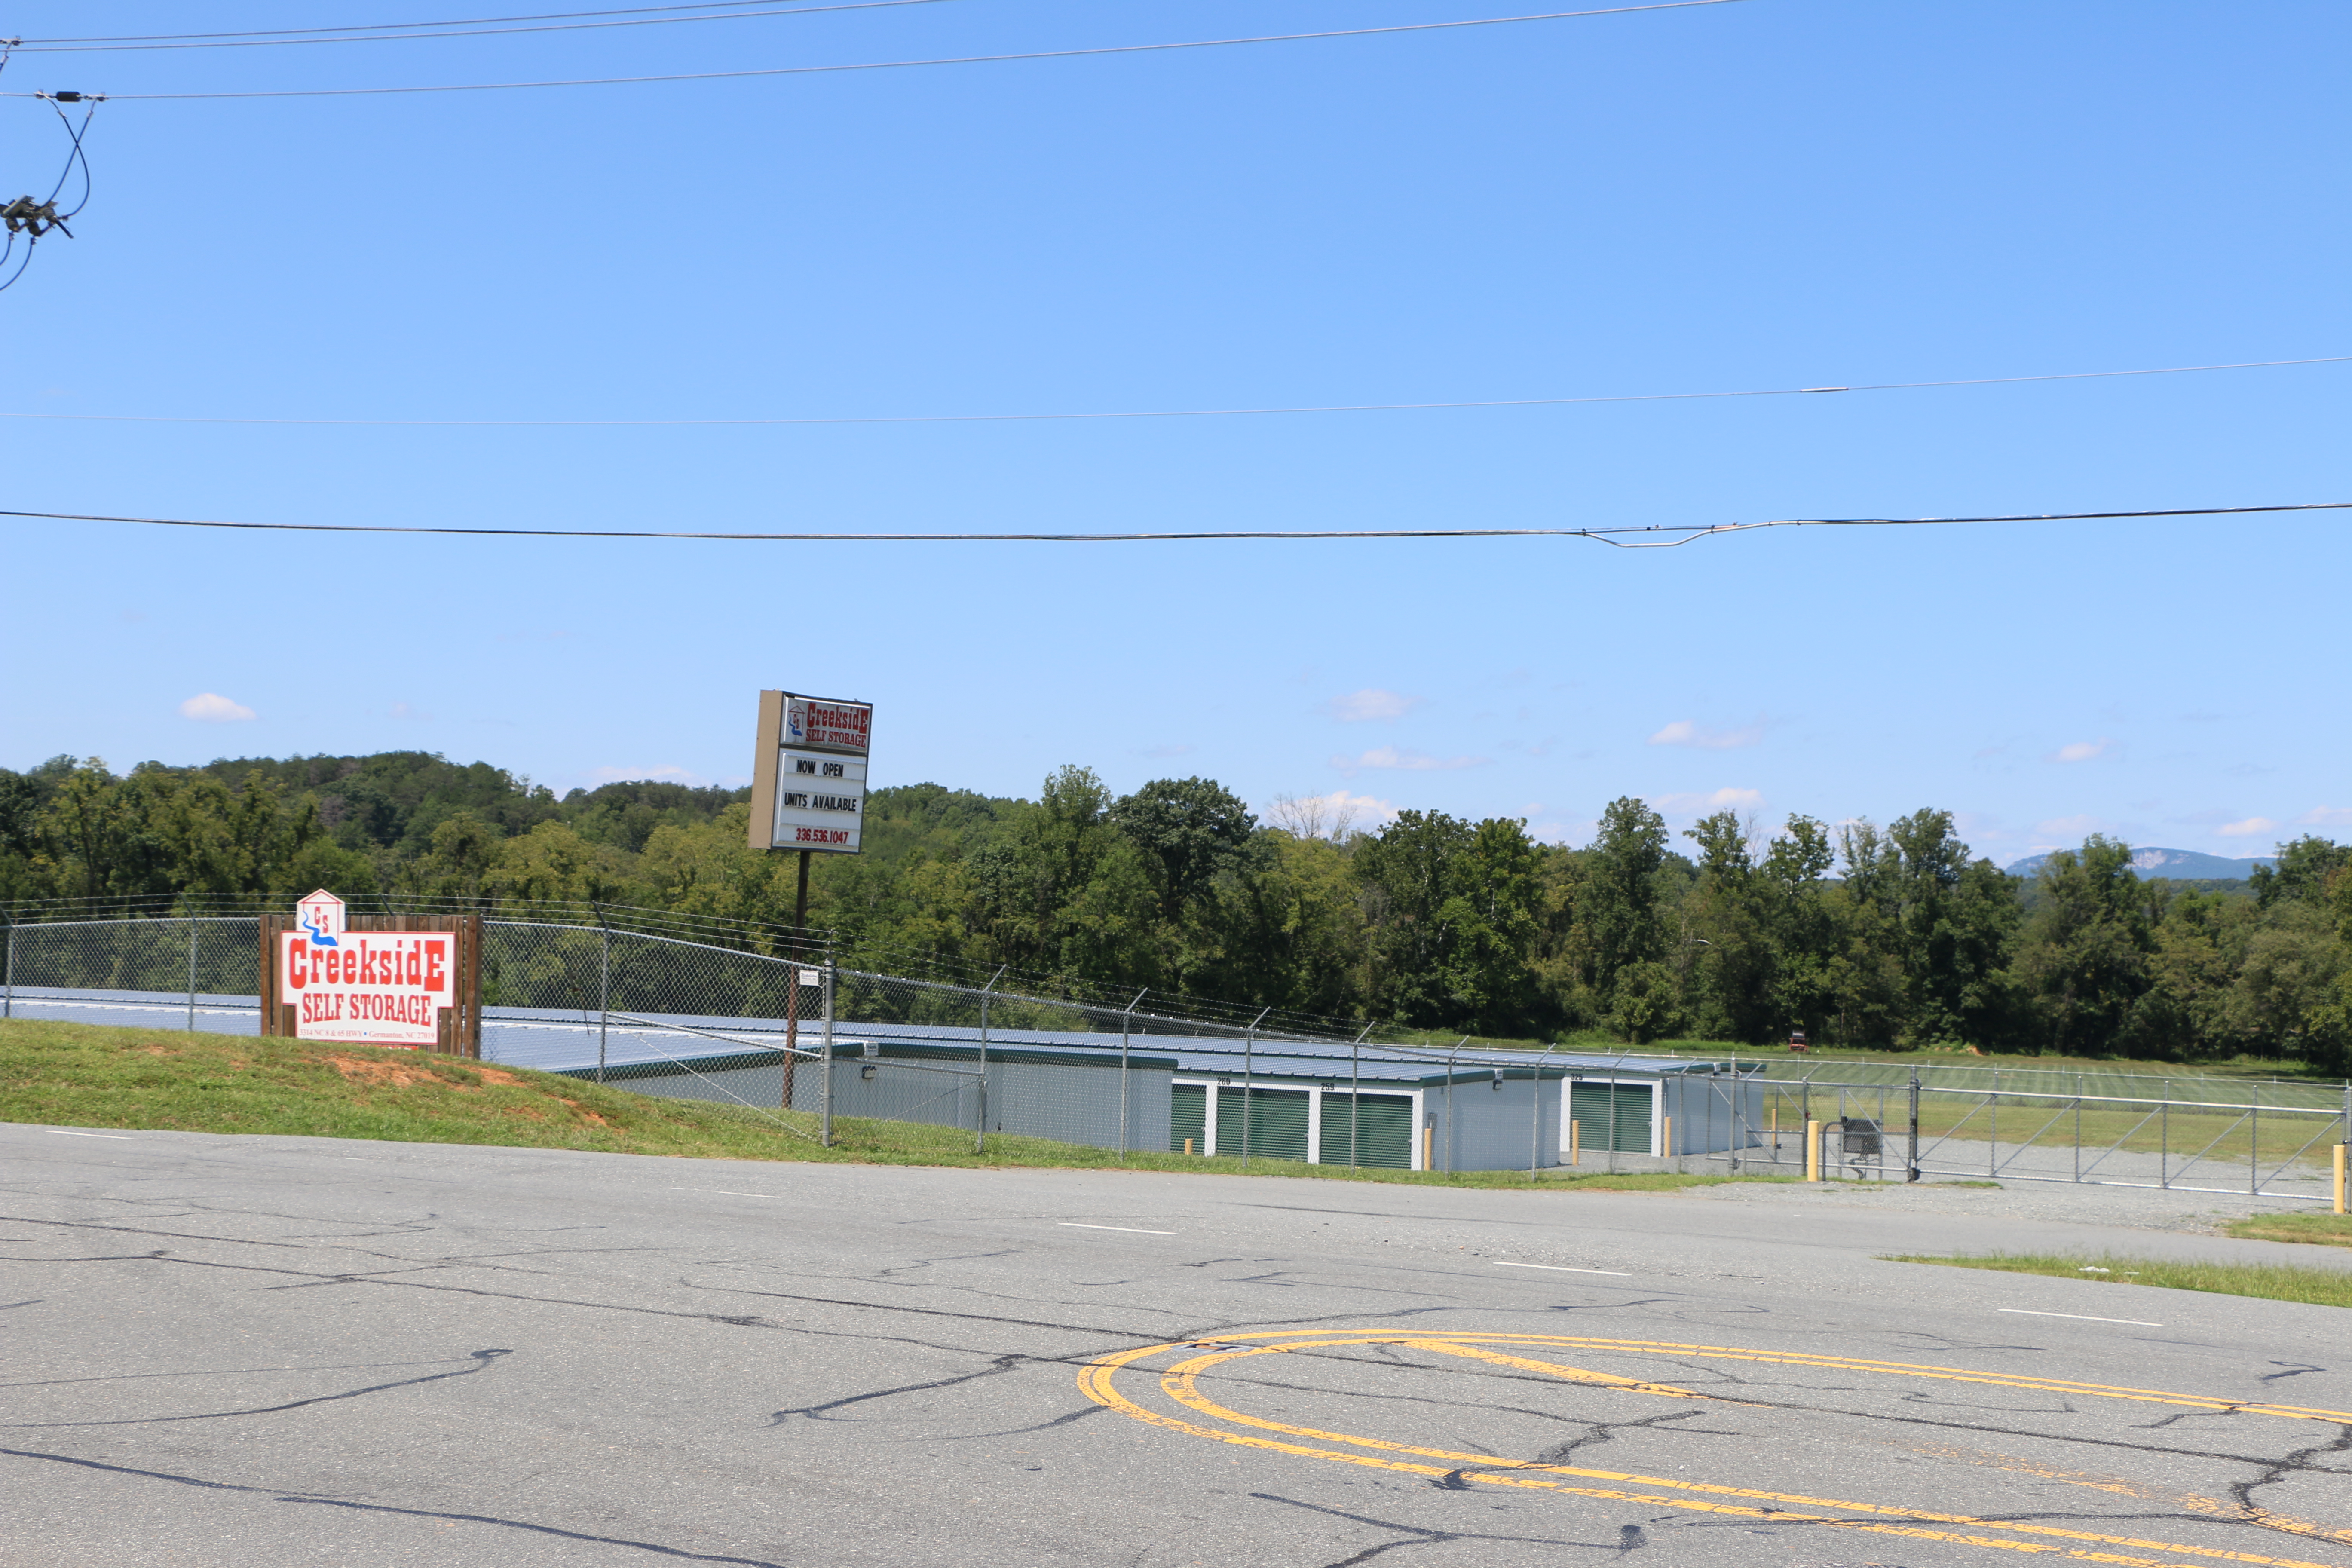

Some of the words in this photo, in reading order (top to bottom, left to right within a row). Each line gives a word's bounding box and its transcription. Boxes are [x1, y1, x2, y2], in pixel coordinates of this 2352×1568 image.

[806, 729, 826, 741] SELF
[829, 731, 866, 747] STORAGE
[797, 760, 816, 774] NOW
[823, 763, 843, 777] OPEN
[784, 793, 807, 807] UNITS
[812, 795, 857, 812] AVAILABLE
[796, 828, 849, 844] 336.536.1047
[303, 992, 344, 1024] SELF
[349, 993, 431, 1027] STORAGE
[1218, 1077, 1230, 1085] 260
[1321, 1082, 1334, 1091] 259
